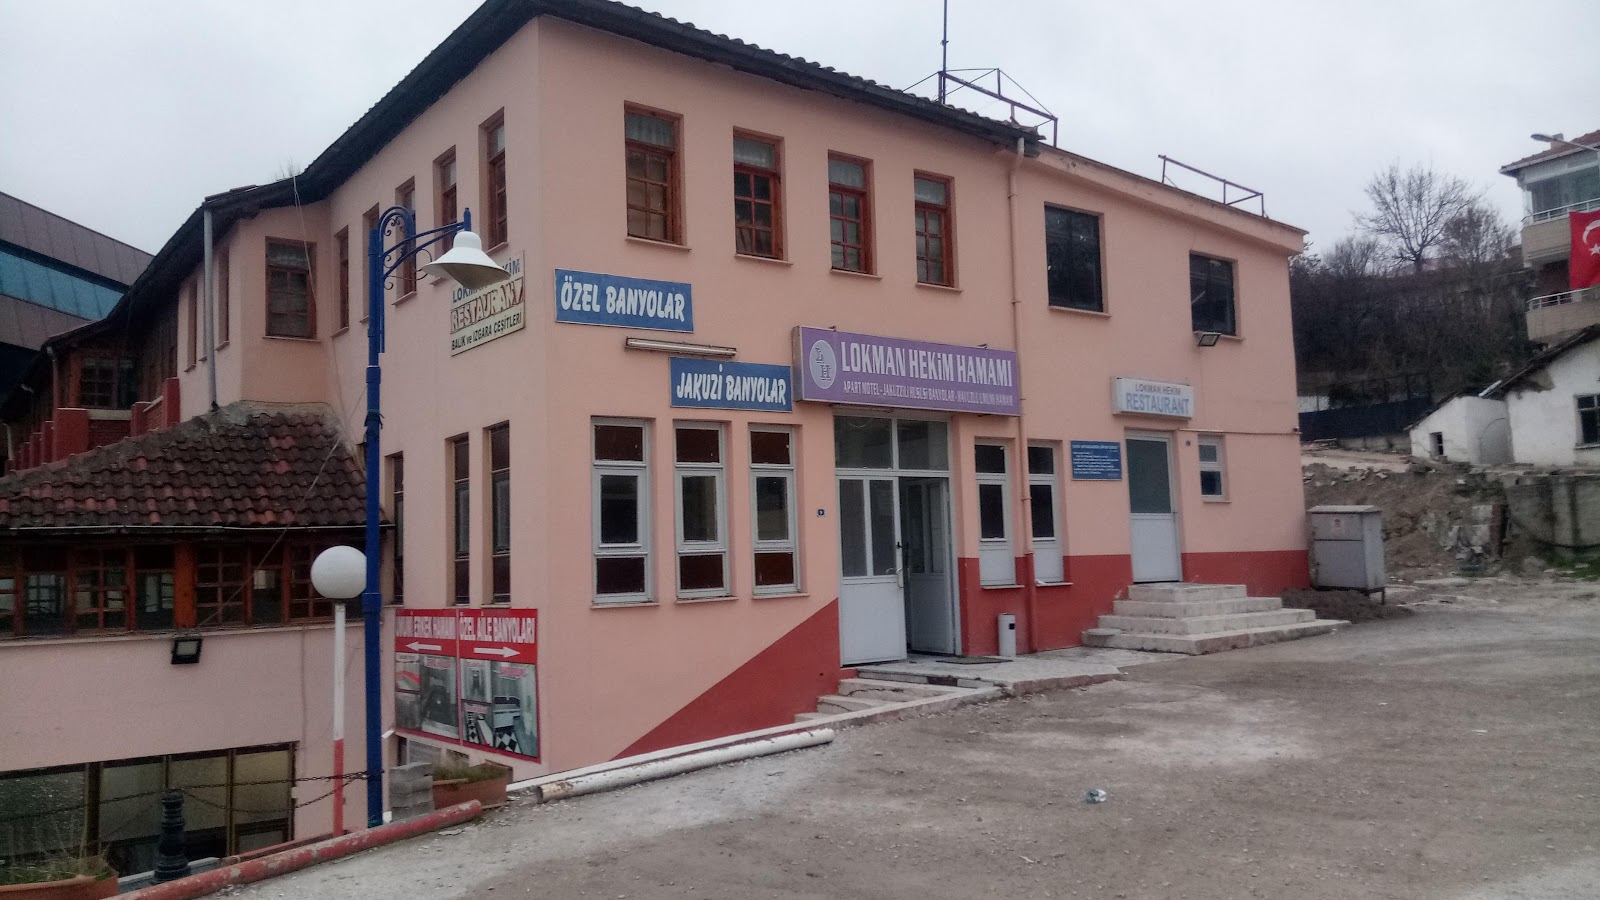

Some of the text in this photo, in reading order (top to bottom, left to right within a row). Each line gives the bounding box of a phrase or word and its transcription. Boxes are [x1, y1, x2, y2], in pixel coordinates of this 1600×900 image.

[450, 278, 523, 334] RESTAURANT
[560, 275, 685, 322] ÖZEL BANYOLAR
[452, 334, 466, 350] BALIK
[473, 325, 492, 342] IZGARA
[841, 341, 906, 377] LOKMAN
[957, 356, 1012, 387] HAMAMI
[676, 364, 786, 406] JAKUZİ BANYOLAR
[843, 381, 861, 395] APART
[862, 381, 879, 396] MOTEL
[928, 387, 954, 402] BANYOLAR
[1135, 384, 1161, 393] LOKMAN
[1126, 392, 1189, 415] RESTAURANT
[460, 611, 535, 644] ÖZEL AİLE BANYOLARI
